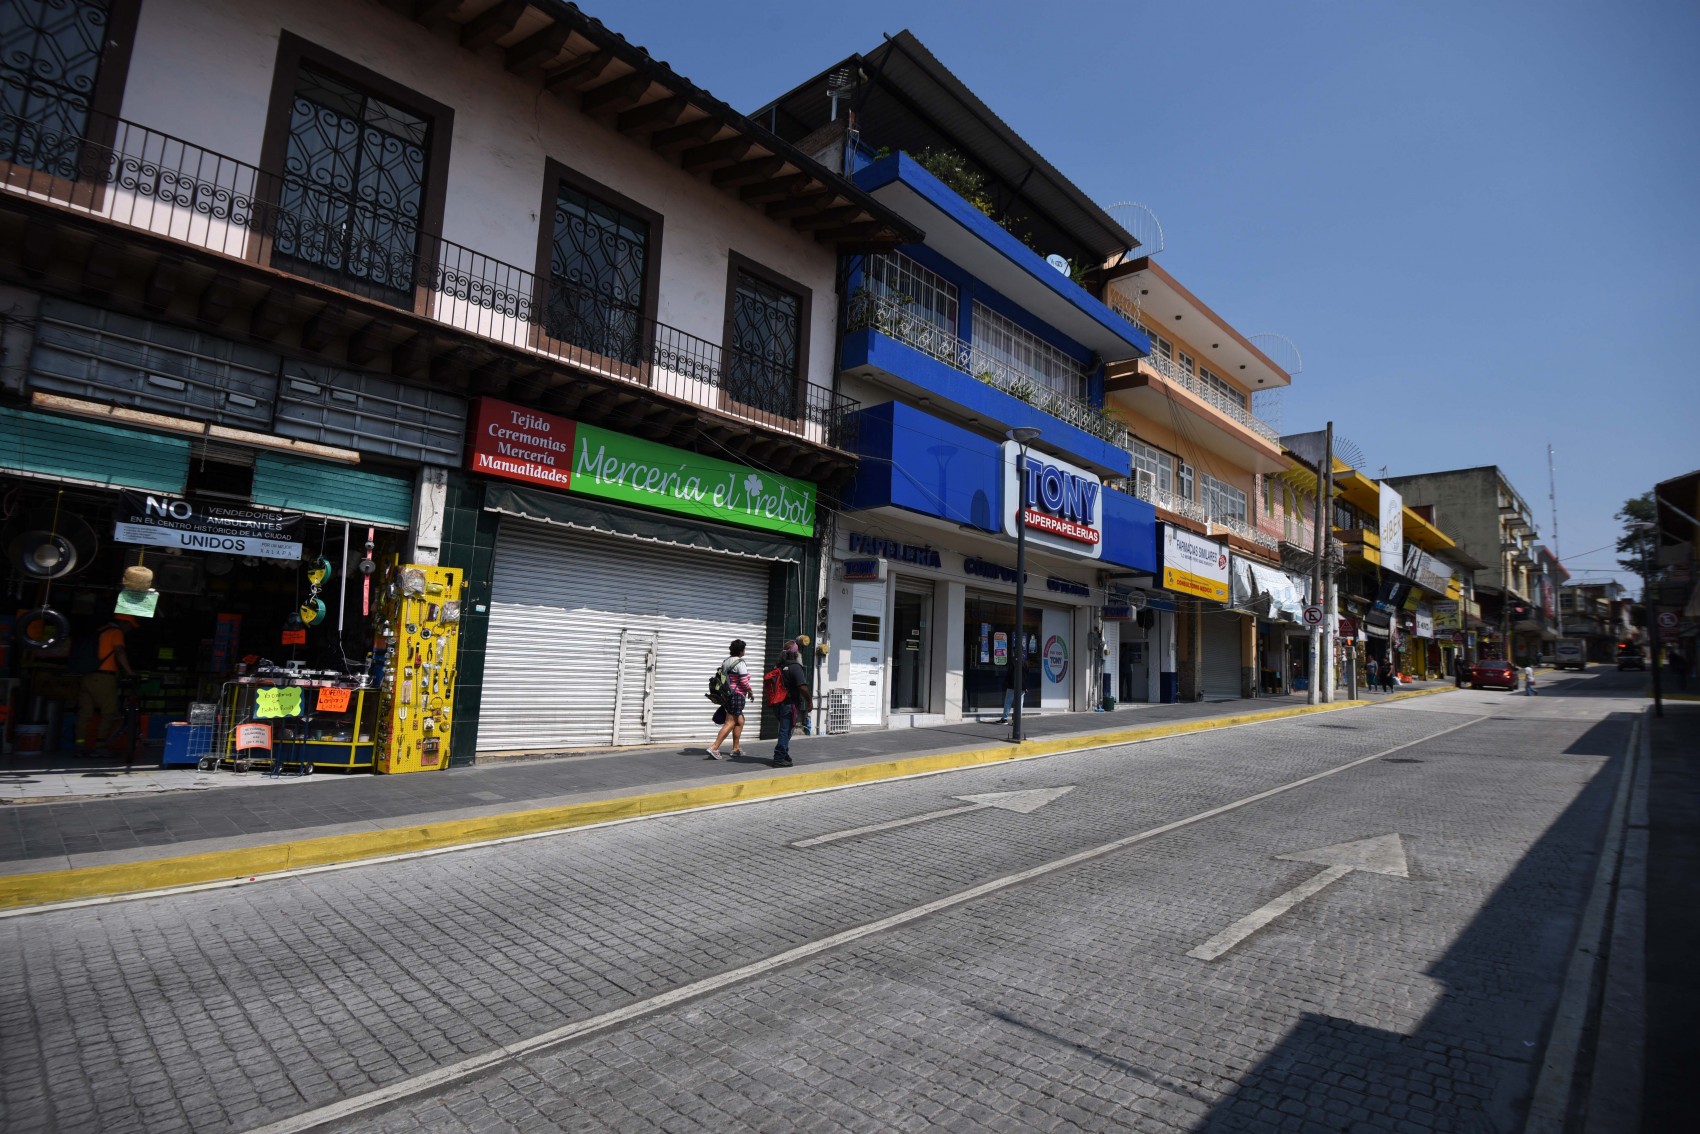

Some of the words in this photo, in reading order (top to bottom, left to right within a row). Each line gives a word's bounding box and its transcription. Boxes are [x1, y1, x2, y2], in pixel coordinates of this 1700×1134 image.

[511, 410, 550, 432] Tejido
[488, 423, 567, 453] Ceremonias
[498, 441, 555, 465] Mercería
[478, 453, 568, 484] Manualidades
[576, 437, 708, 501] Mercería
[713, 472, 740, 510] el
[1016, 454, 1099, 525] TONY
[146, 496, 192, 520] NO
[208, 506, 283, 521] VENDEDORES
[130, 515, 142, 523] EN
[144, 517, 155, 525] EL
[157, 519, 192, 530] CENTRO
[239, 529, 251, 537] DE
[264, 532, 292, 541] CIUDAD
[206, 516, 283, 531] AMBULANTES
[1024, 511, 1099, 542] SUPERPAPELERIAS
[181, 533, 245, 551] UNIDOS
